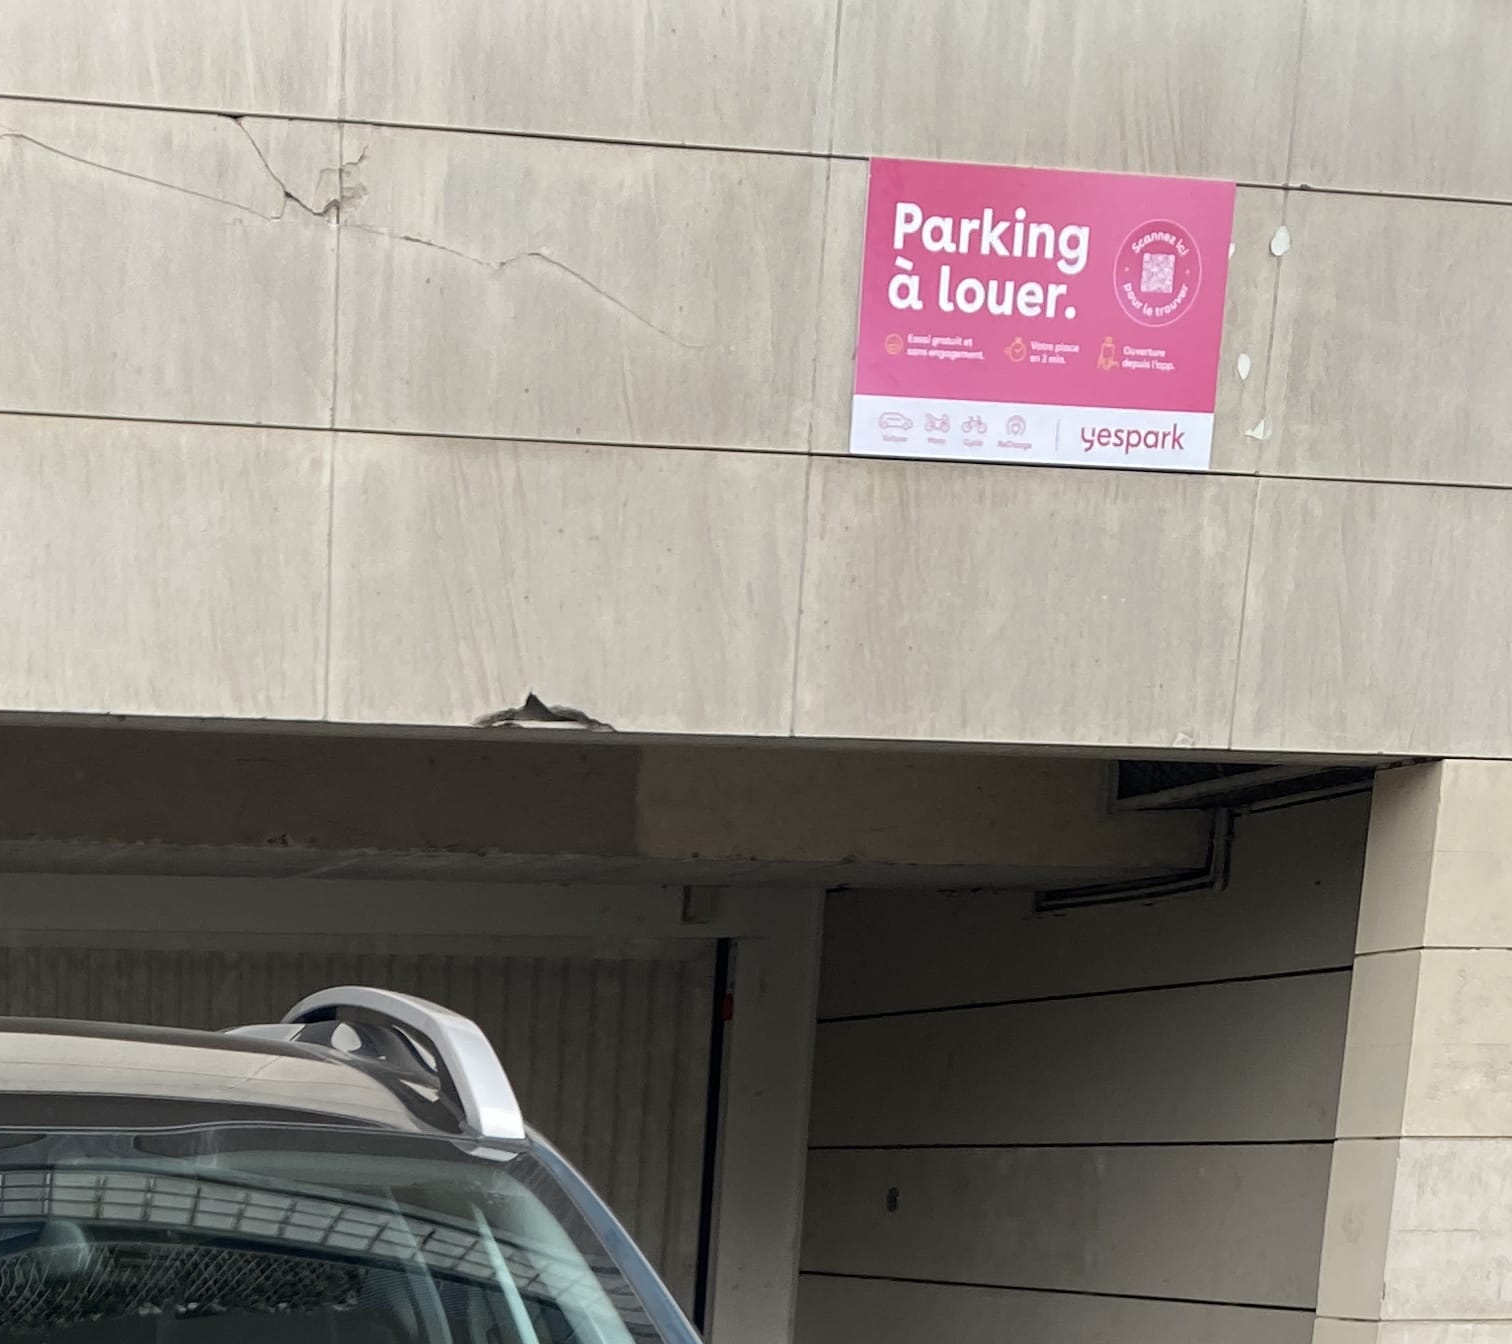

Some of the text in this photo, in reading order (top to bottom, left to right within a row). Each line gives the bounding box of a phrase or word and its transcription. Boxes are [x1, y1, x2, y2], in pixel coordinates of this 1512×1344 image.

[893, 202, 1090, 275] Parking
[1131, 231, 1190, 256] Scannez ici
[888, 256, 1077, 319] à louer.
[1123, 282, 1189, 317] pour le trouver
[1080, 423, 1185, 455] yespark
